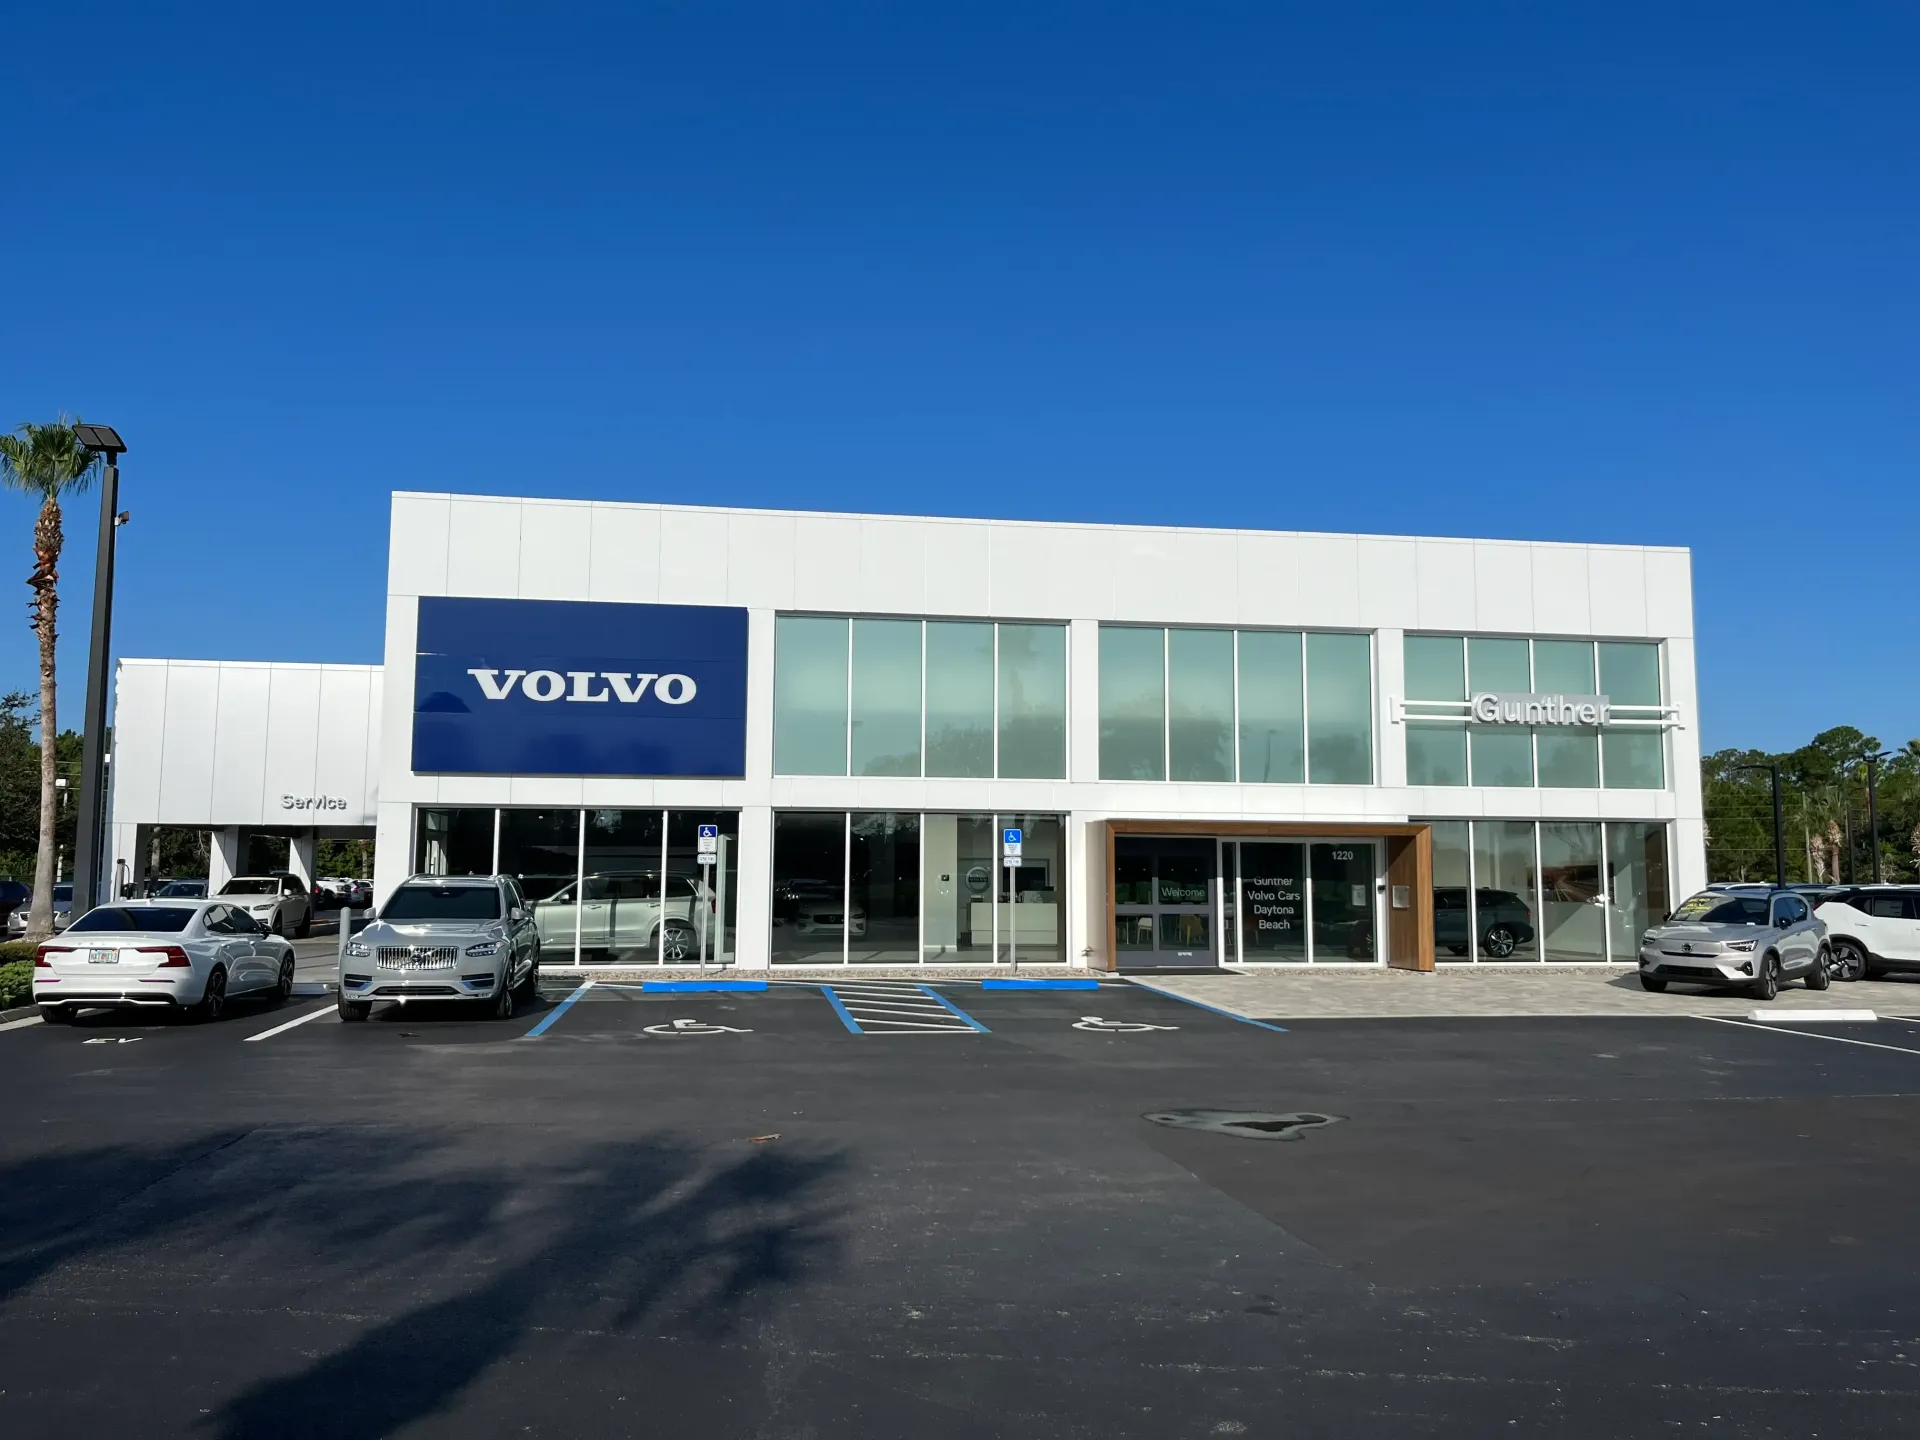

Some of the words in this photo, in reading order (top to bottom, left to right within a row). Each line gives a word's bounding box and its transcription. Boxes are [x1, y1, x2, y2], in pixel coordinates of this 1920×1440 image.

[467, 669, 697, 704] VOLVO
[1476, 693, 1610, 724] Gunther
[281, 794, 347, 810] Service
[1331, 851, 1354, 860] 1220
[1161, 887, 1205, 897] Welcome
[1247, 891, 1275, 900] Volvo
[1277, 891, 1301, 900] Cars
[1253, 905, 1295, 916] Daytona
[1258, 920, 1291, 930] Beach
